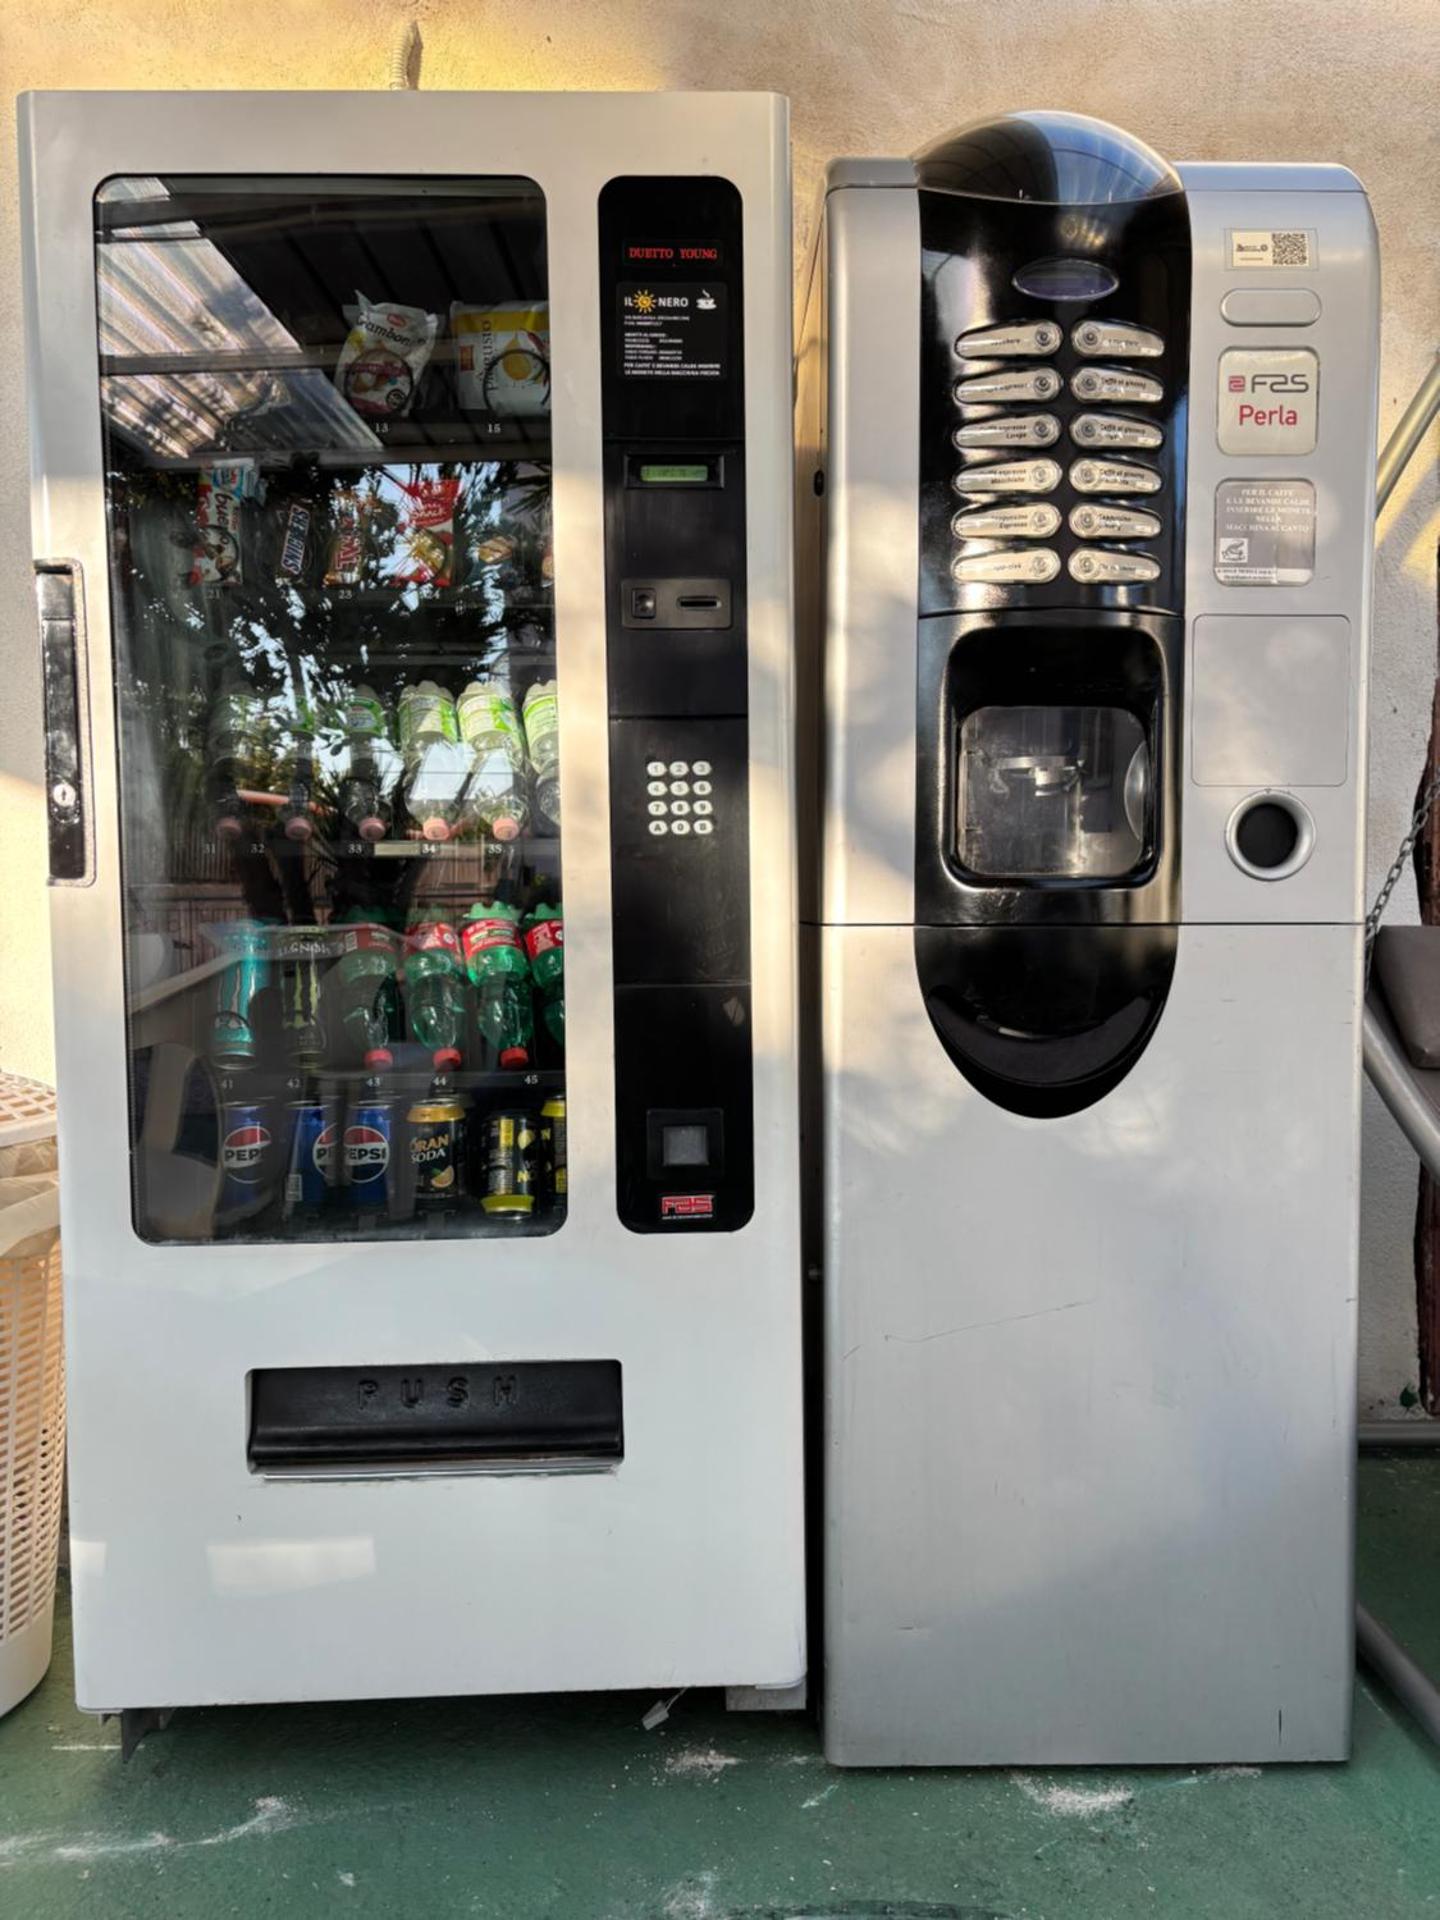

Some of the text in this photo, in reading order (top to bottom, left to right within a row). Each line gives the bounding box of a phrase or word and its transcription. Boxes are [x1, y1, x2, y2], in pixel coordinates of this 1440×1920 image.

[629, 247, 718, 259] DUETTO YOUNG
[624, 296, 689, 308] IL NERO
[1239, 404, 1298, 426] Perla
[375, 422, 390, 433] 13
[487, 423, 502, 434] 15
[421, 843, 436, 854] 34
[433, 1076, 448, 1086] 44
[524, 1074, 539, 1085] 45
[410, 1148, 446, 1164] SODA
[357, 1374, 519, 1410] PUSH
